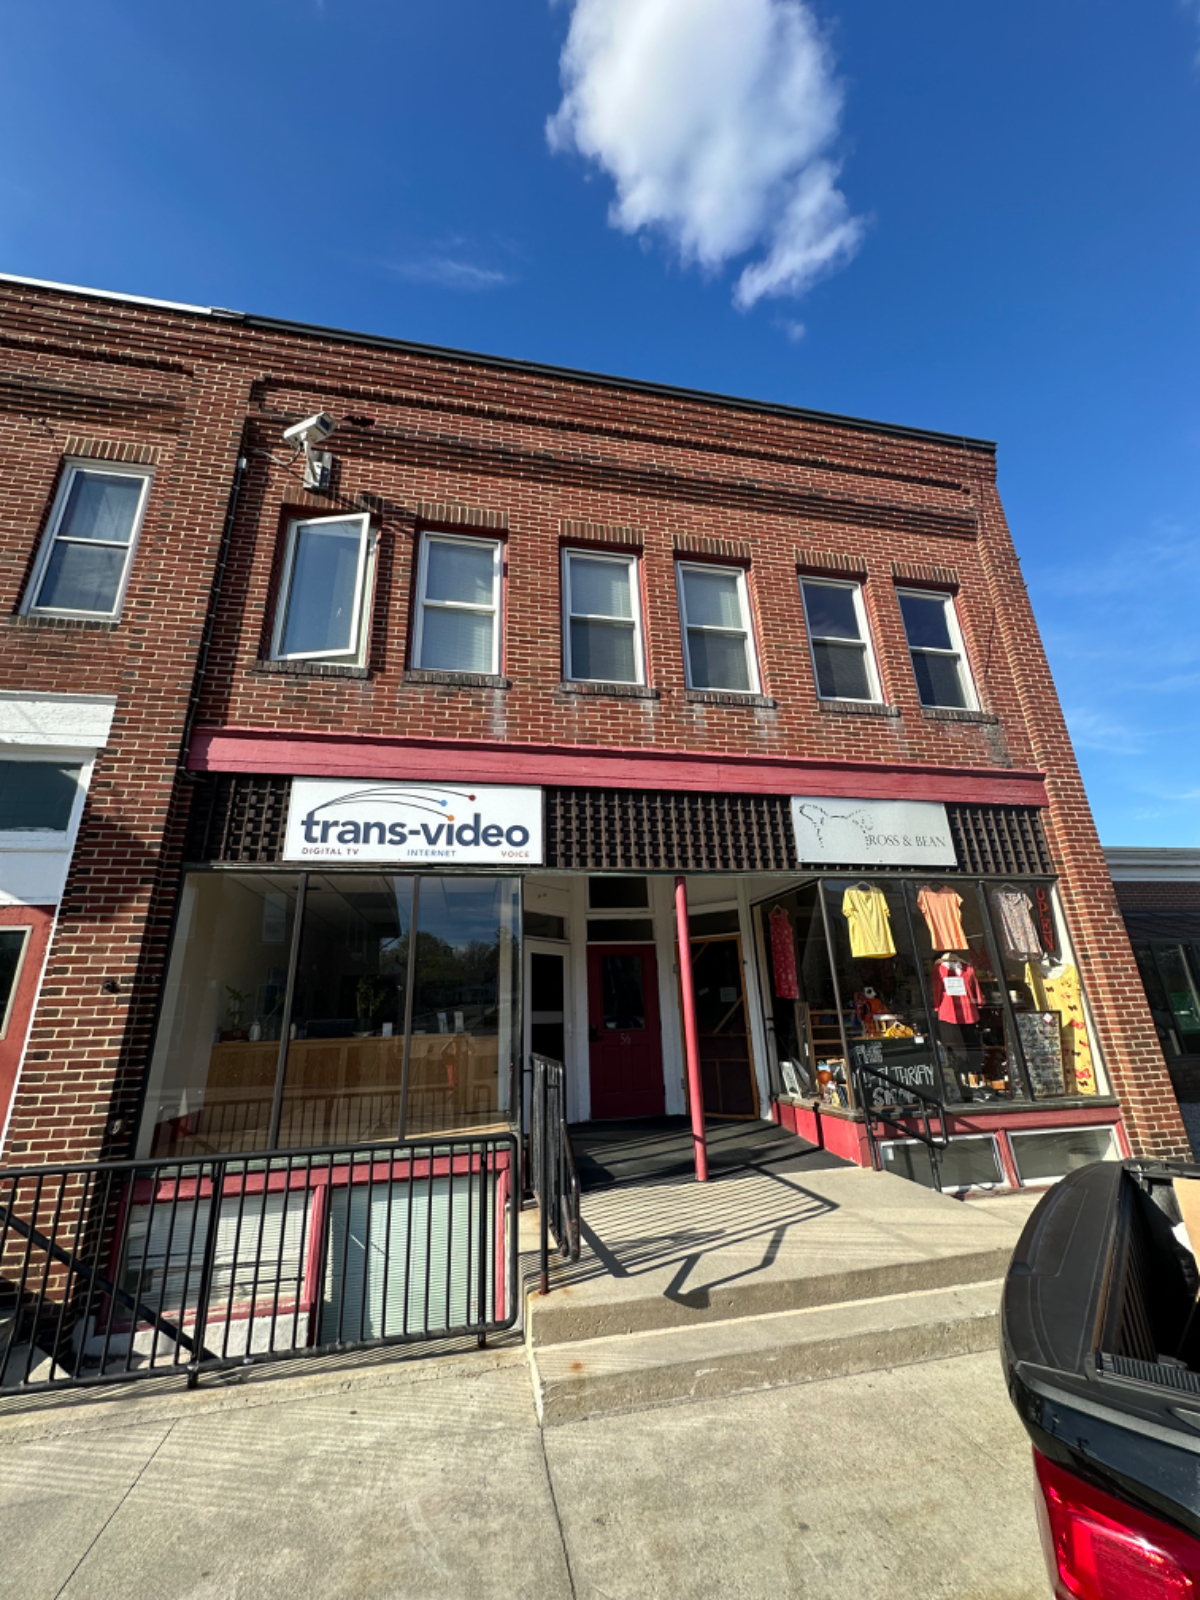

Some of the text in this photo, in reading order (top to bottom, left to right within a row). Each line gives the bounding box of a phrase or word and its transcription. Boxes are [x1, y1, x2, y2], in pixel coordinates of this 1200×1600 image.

[300, 813, 530, 847] trans-video
[868, 834, 946, 847] ROSS & BEAN
[301, 847, 360, 856] DIGITAL TV
[406, 848, 456, 858] INTERNET
[501, 850, 530, 858] VOICE
